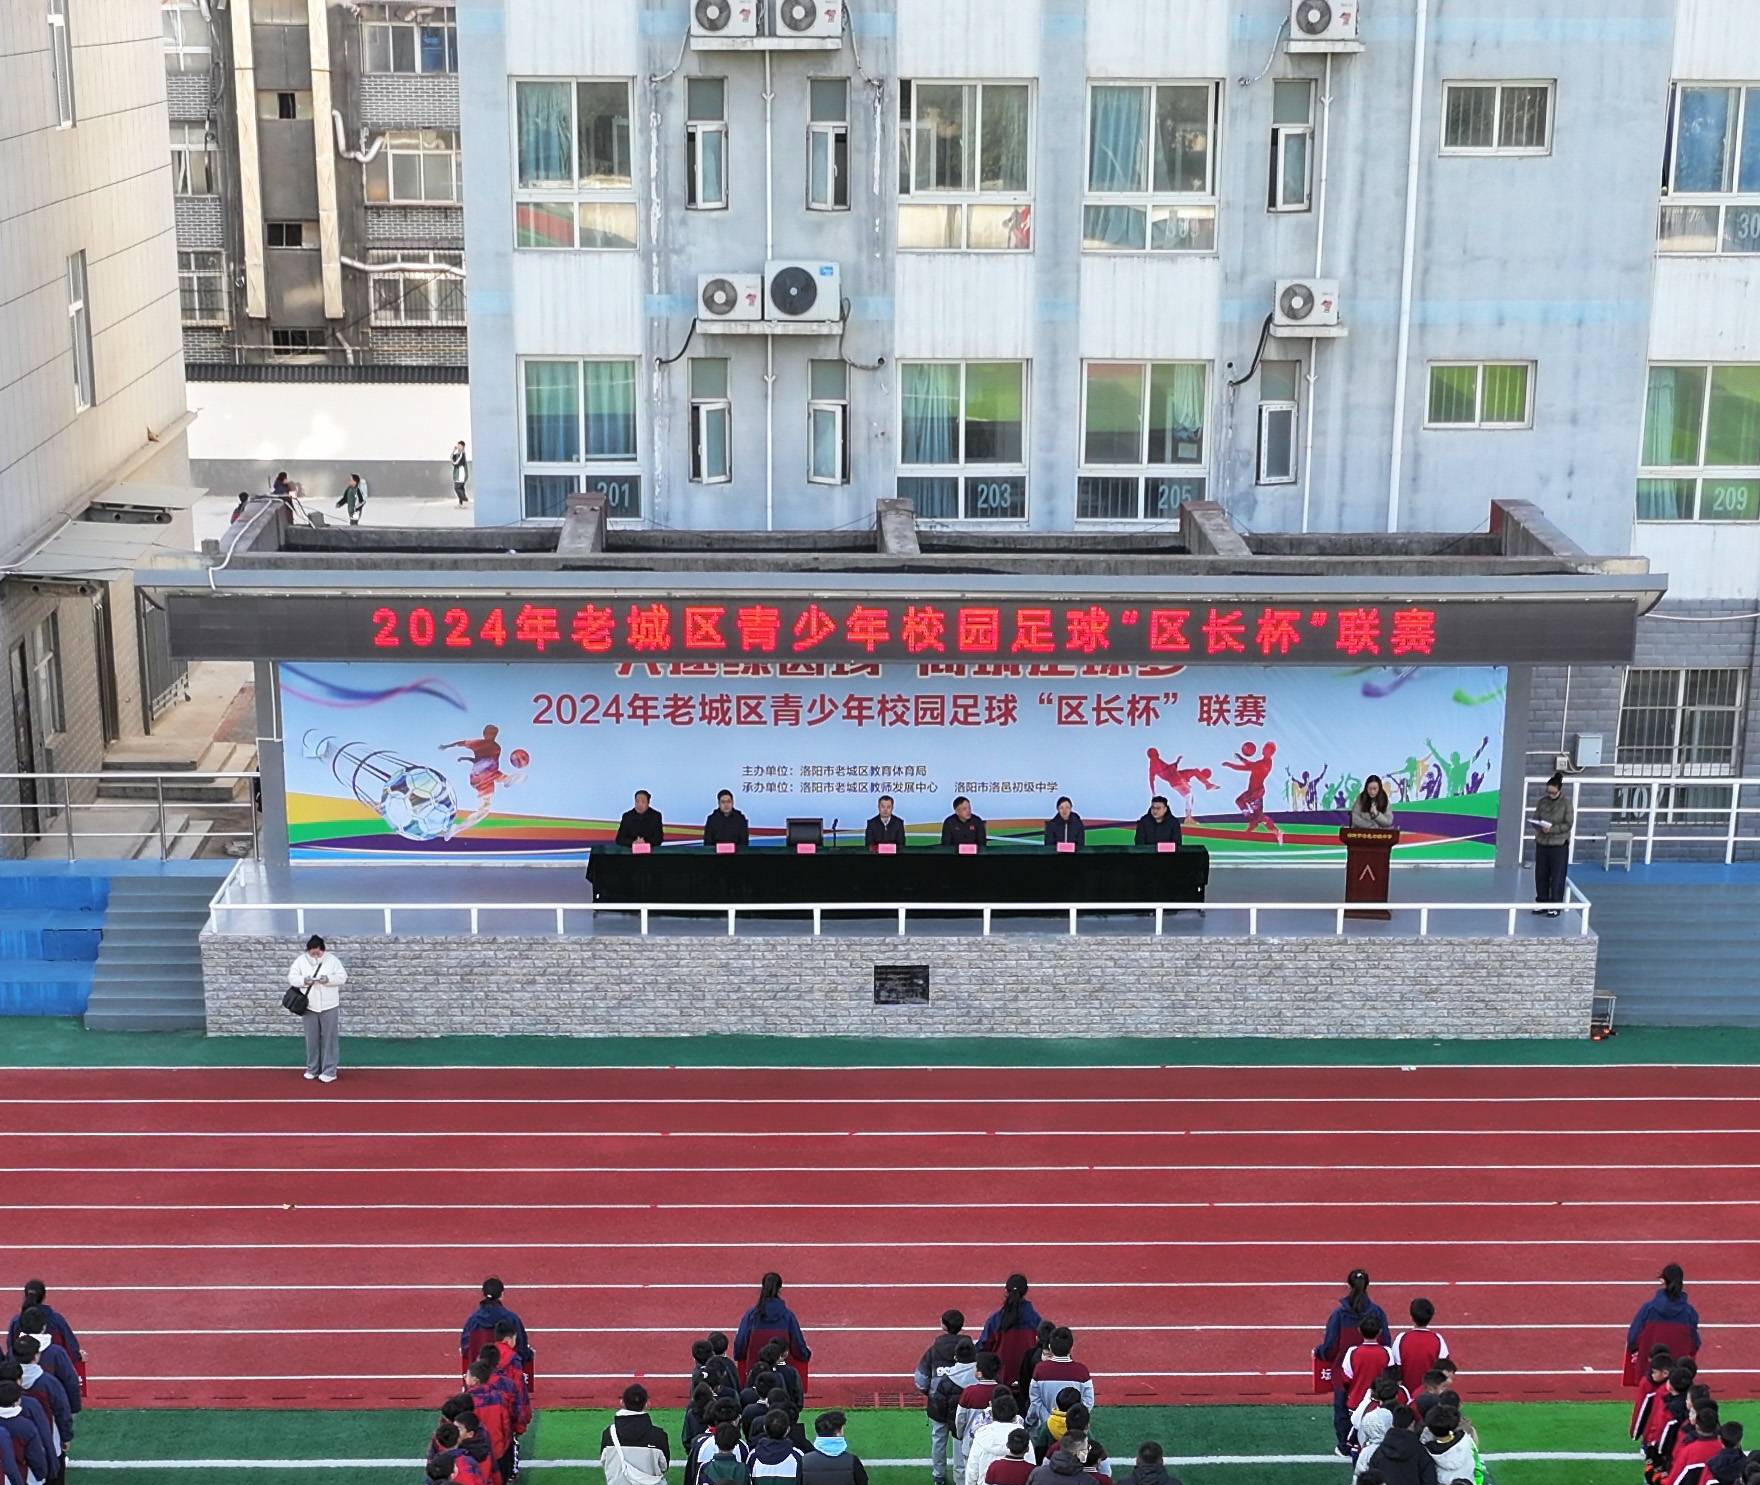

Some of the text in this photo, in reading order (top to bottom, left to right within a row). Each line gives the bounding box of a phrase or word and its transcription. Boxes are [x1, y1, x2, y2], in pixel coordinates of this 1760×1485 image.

[978, 483, 1011, 508] 203
[1158, 485, 1192, 509] 205
[1713, 486, 1748, 511] 209
